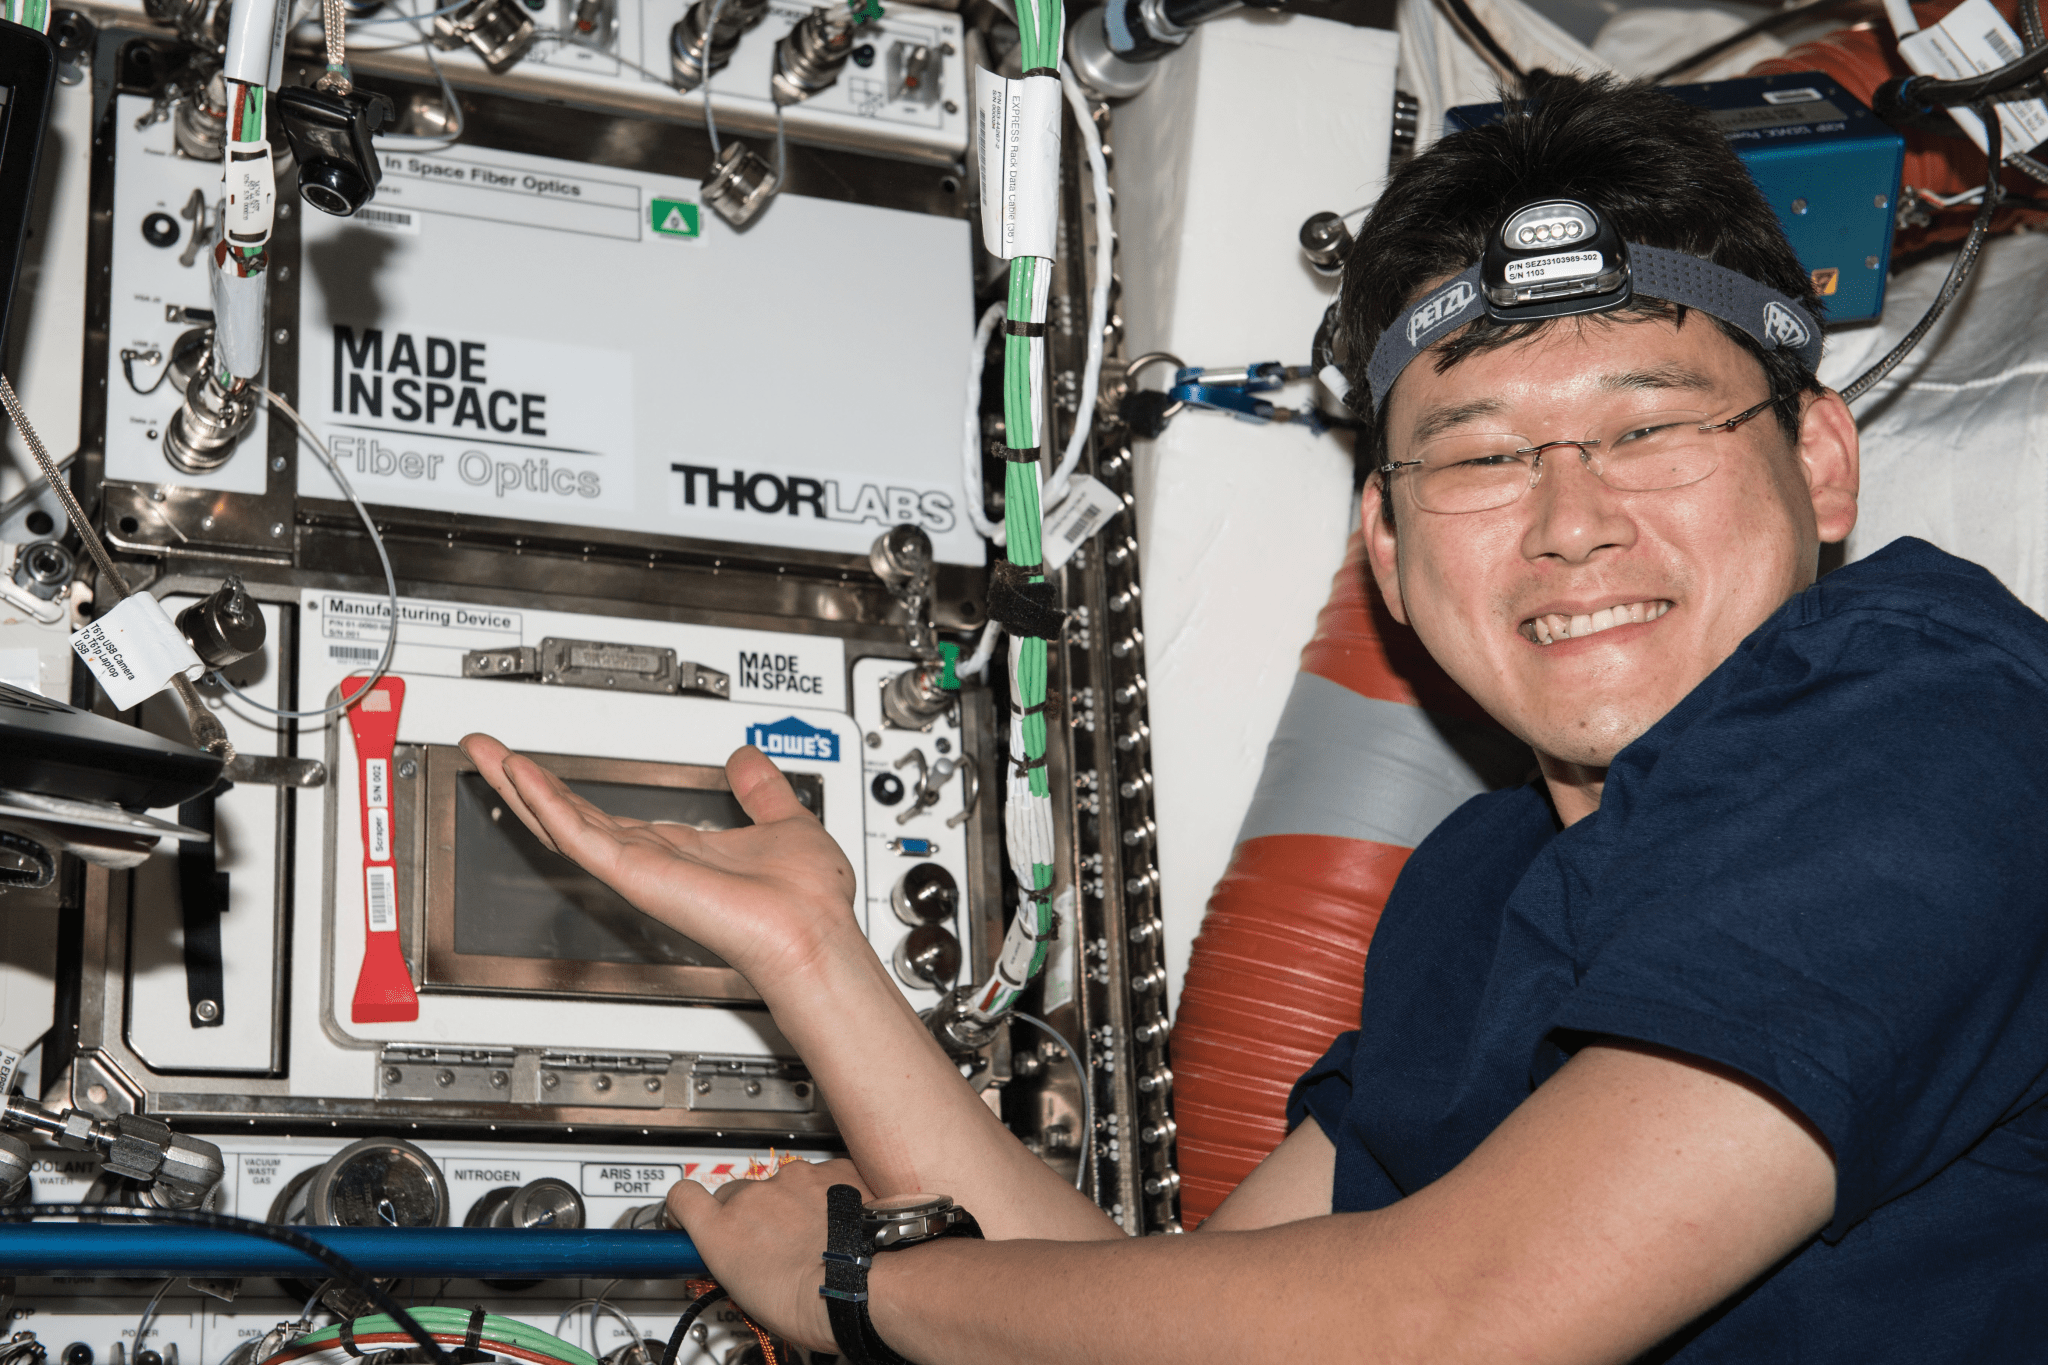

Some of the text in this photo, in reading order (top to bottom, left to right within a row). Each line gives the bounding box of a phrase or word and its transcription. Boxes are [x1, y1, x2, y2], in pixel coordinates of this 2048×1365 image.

[1010, 95, 1021, 143] EXPRESS
[1009, 144, 1019, 168] Rack
[385, 155, 581, 197] In Space Fiber Optics
[1008, 170, 1018, 192] Data
[1525, 254, 1598, 269] SEZ33103989-302
[1509, 268, 1545, 280] S/N 1103
[1408, 284, 1477, 347] PETZL
[333, 324, 487, 384] MADE
[333, 372, 547, 437] IN SPACE
[328, 434, 602, 499] Fiber Optics
[671, 463, 956, 533] THORLABS
[456, 609, 512, 629] Device
[74, 639, 91, 656] USB
[80, 628, 119, 679] To T61p Laptop
[90, 623, 136, 681] T61p USB Camera
[739, 651, 799, 673] MADE
[739, 671, 823, 695] IN SPACE
[754, 728, 832, 758] LOWE'S
[373, 764, 382, 803] S/N 002
[375, 816, 385, 853] Scraper
[31, 1161, 96, 1174] OOLANT
[244, 1158, 281, 1168] VACUUM
[247, 1168, 277, 1176] WASTE
[38, 1177, 75, 1186] WATER
[252, 1176, 271, 1185] GAS
[454, 1169, 521, 1182] NITROGEN
[599, 1168, 666, 1181] ARIS 1553
[613, 1182, 652, 1194] PORT
[238, 1329, 264, 1338] DATA
